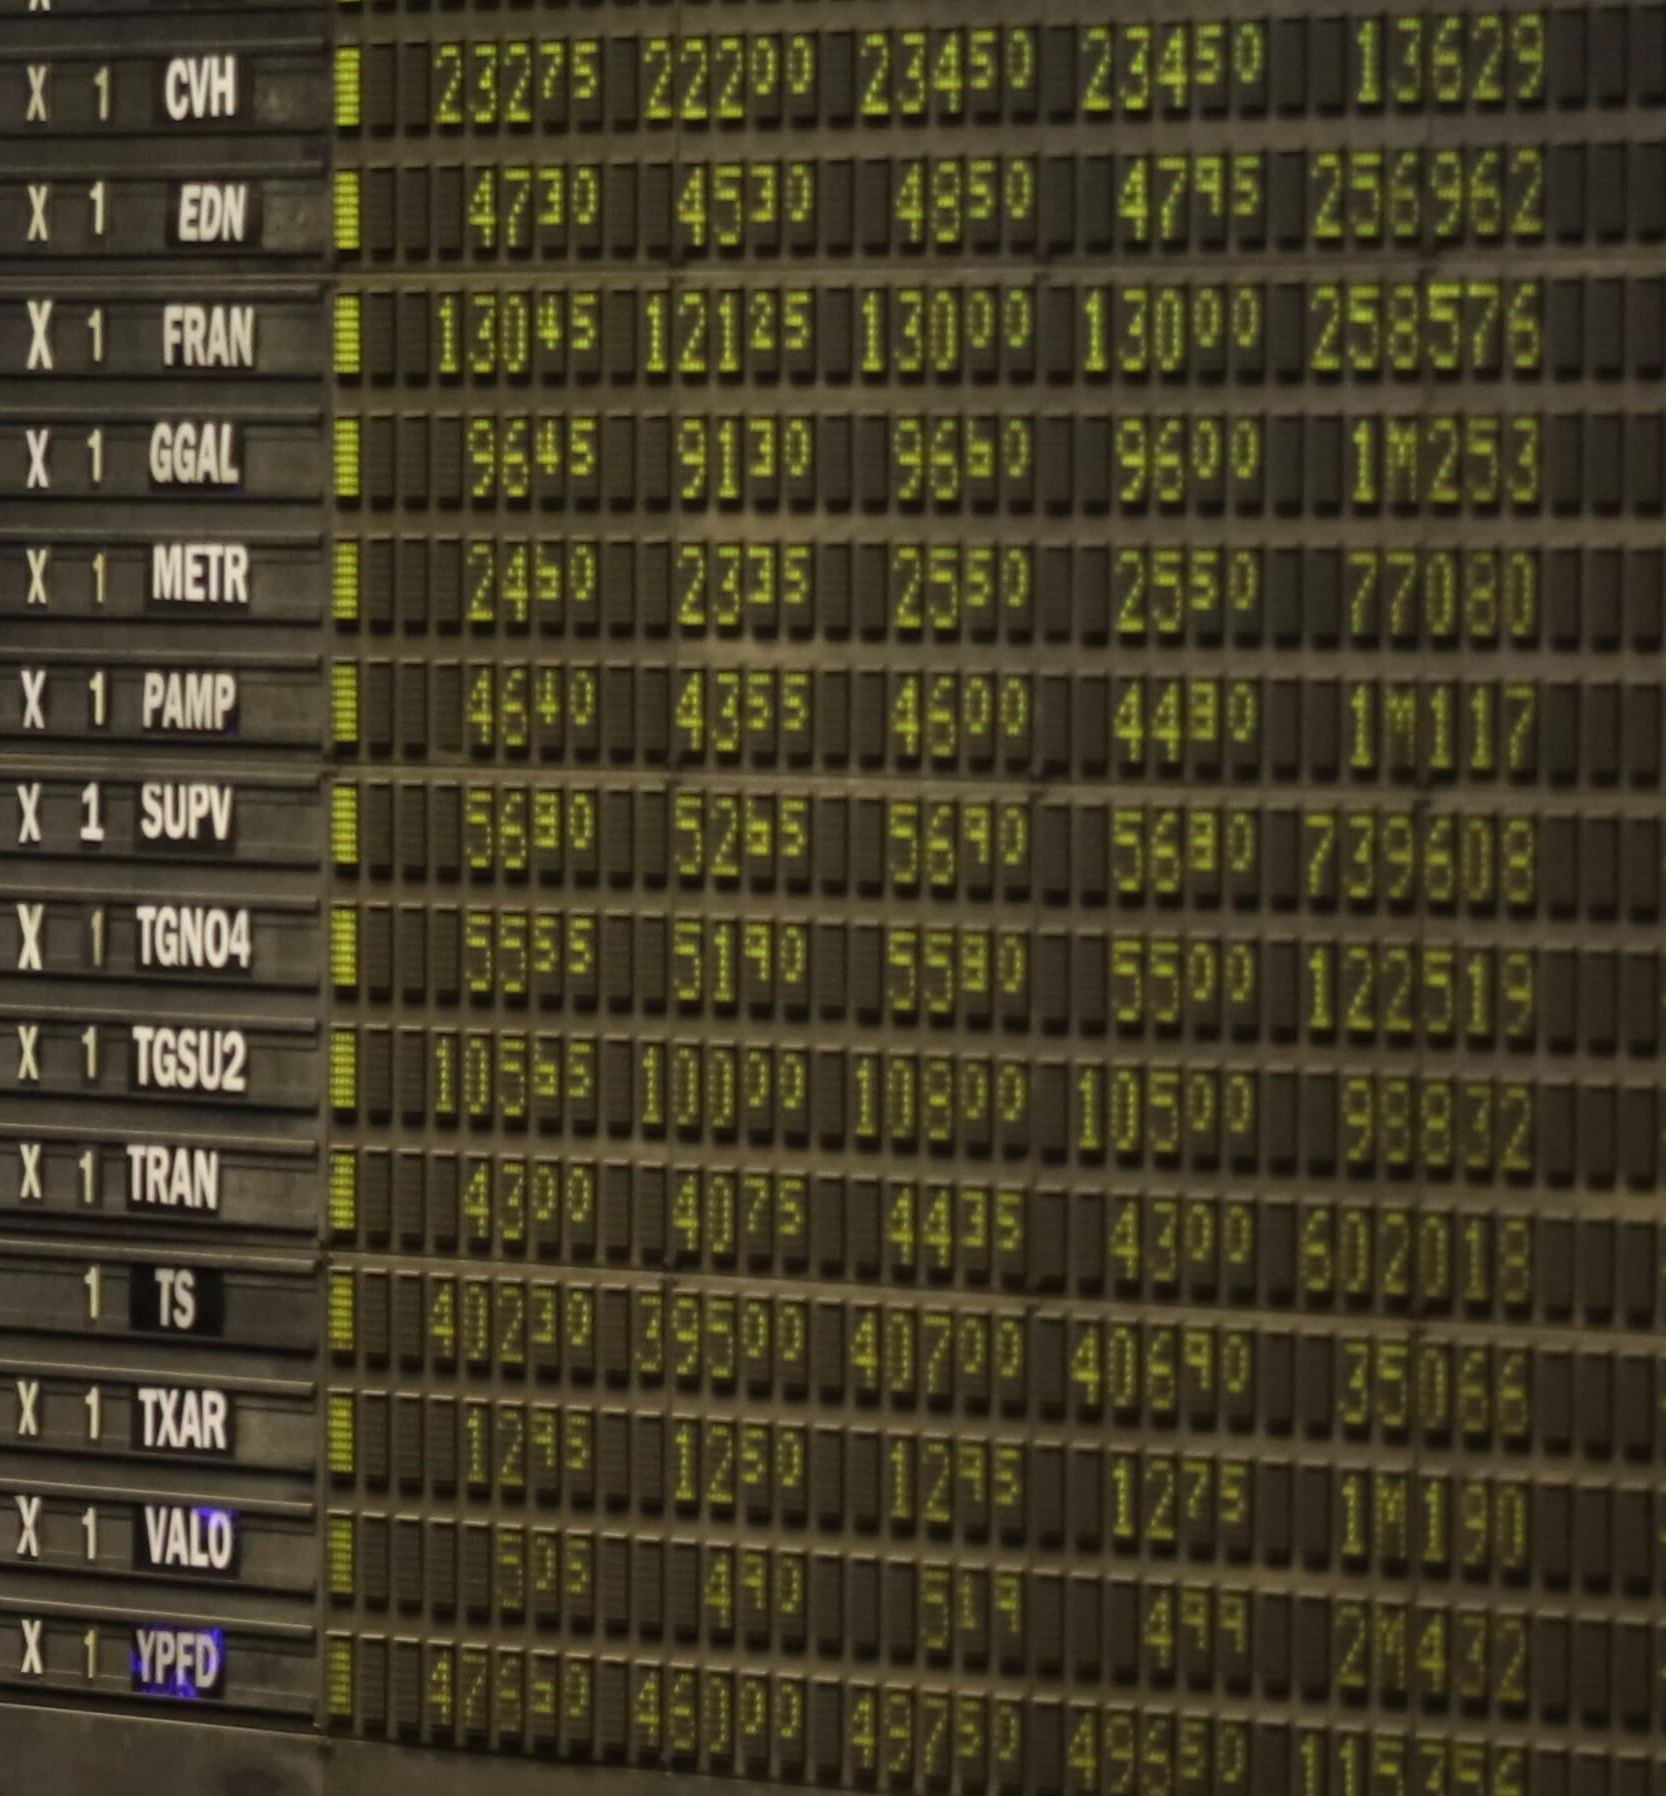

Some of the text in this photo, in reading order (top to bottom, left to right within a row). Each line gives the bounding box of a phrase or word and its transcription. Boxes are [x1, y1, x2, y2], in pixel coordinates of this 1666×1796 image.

[27, 66, 47, 120] X
[95, 67, 108, 119] 1
[166, 56, 235, 120] CVH
[28, 186, 48, 240] X
[90, 182, 104, 234] 1
[179, 184, 246, 240] EDN
[27, 300, 52, 369] X
[88, 309, 102, 361] 1
[164, 305, 253, 365] FRAN
[26, 429, 48, 487] X
[88, 429, 101, 481] 1
[150, 422, 238, 483] GGAL
[27, 549, 47, 603] X
[93, 554, 105, 602] 1
[153, 543, 248, 602] METR
[21, 670, 45, 728] X
[90, 672, 103, 724] 1
[143, 672, 235, 729] PAMP
[18, 784, 41, 842] X
[81, 783, 104, 840] 1
[142, 784, 231, 839] SUPV
[17, 904, 43, 970] X
[91, 910, 103, 965] 1
[137, 906, 250, 967] TGNO4
[18, 1026, 38, 1079] X
[82, 1026, 96, 1077] 1
[133, 1026, 246, 1091] TGSU2
[20, 1144, 41, 1198] X
[79, 1151, 93, 1202] 1
[127, 1145, 218, 1208] TRAN
[85, 1267, 99, 1318] 1
[156, 1269, 195, 1328] TS
[17, 1381, 38, 1435] X
[85, 1387, 99, 1439] 1
[139, 1389, 226, 1448] TXAR
[17, 1496, 40, 1556] X
[82, 1508, 96, 1559] 1
[146, 1507, 232, 1568] VALO
[21, 1620, 42, 1674] X
[84, 1630, 96, 1678] 1
[135, 1628, 219, 1688] YPFD
